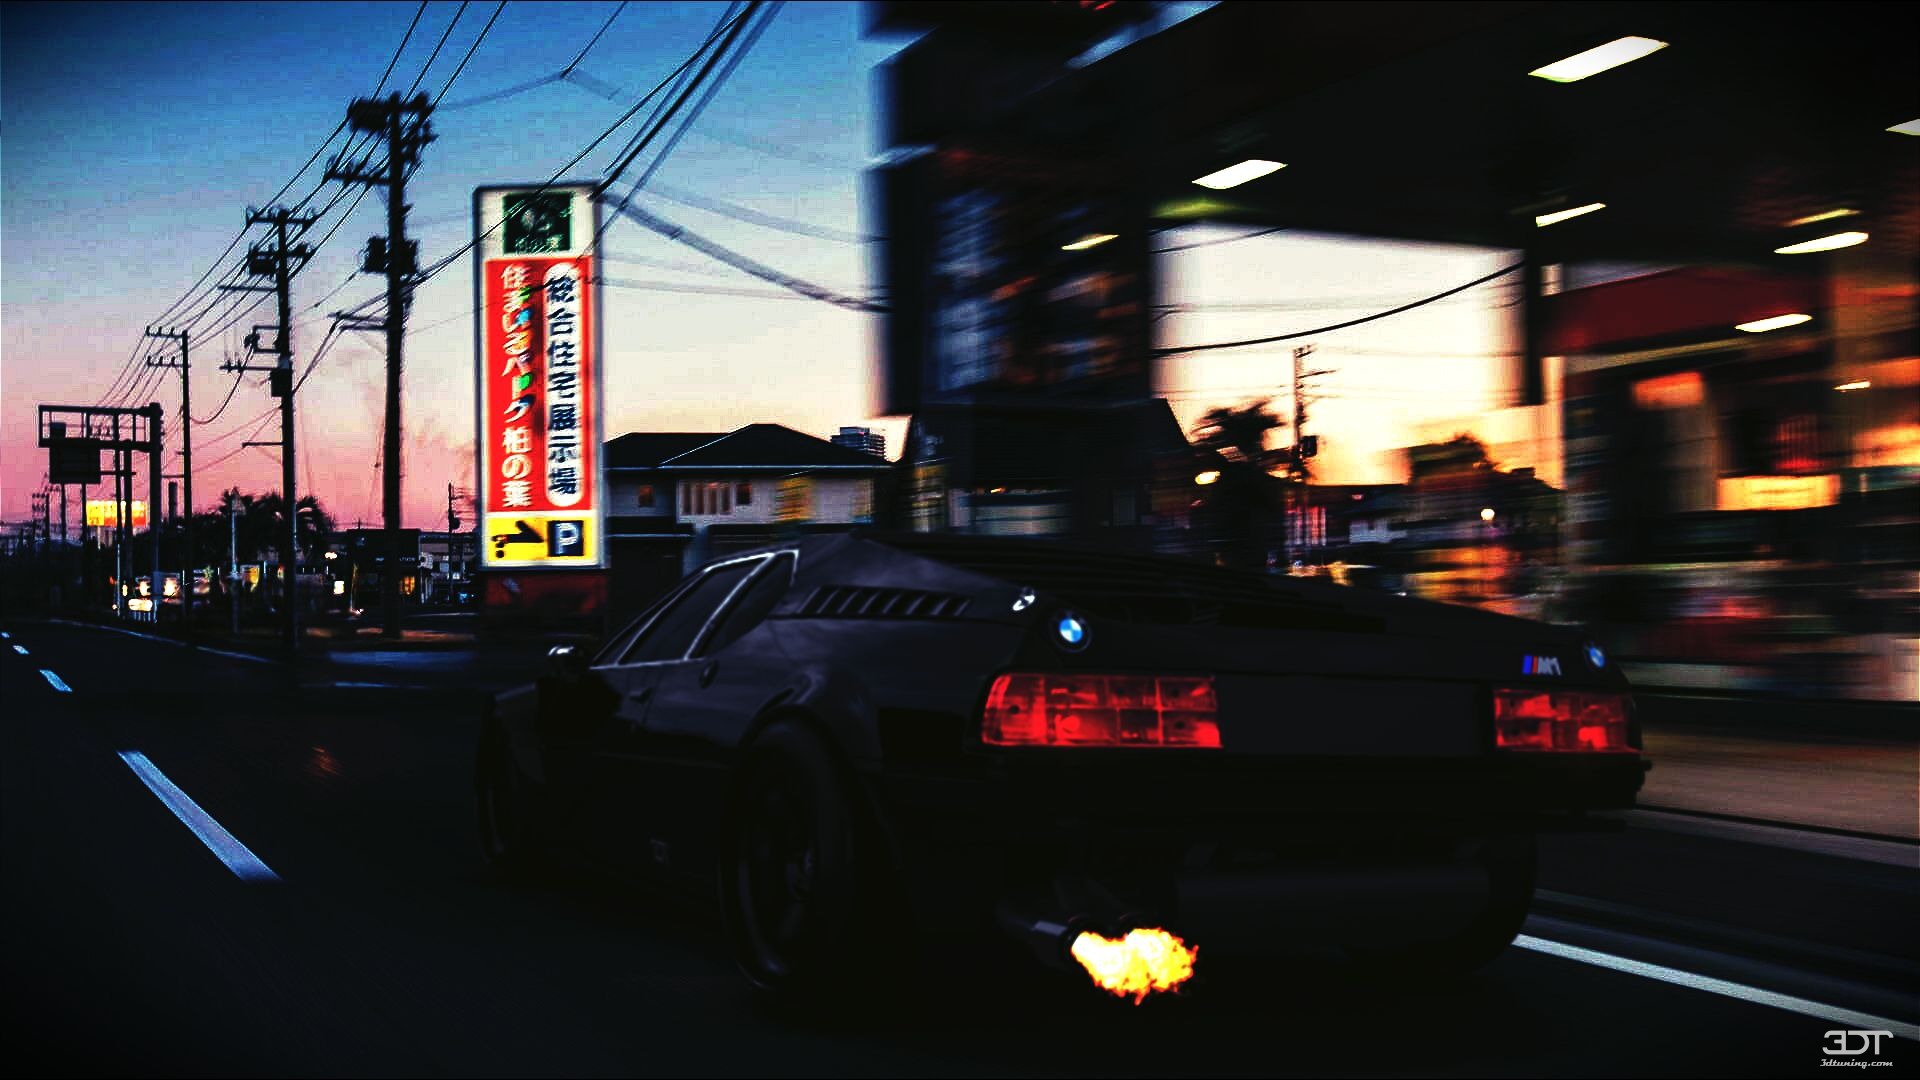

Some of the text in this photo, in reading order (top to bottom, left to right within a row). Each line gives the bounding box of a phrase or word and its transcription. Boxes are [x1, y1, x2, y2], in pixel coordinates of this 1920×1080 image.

[547, 275, 578, 495] 総合住宅展示場
[555, 521, 580, 555] P
